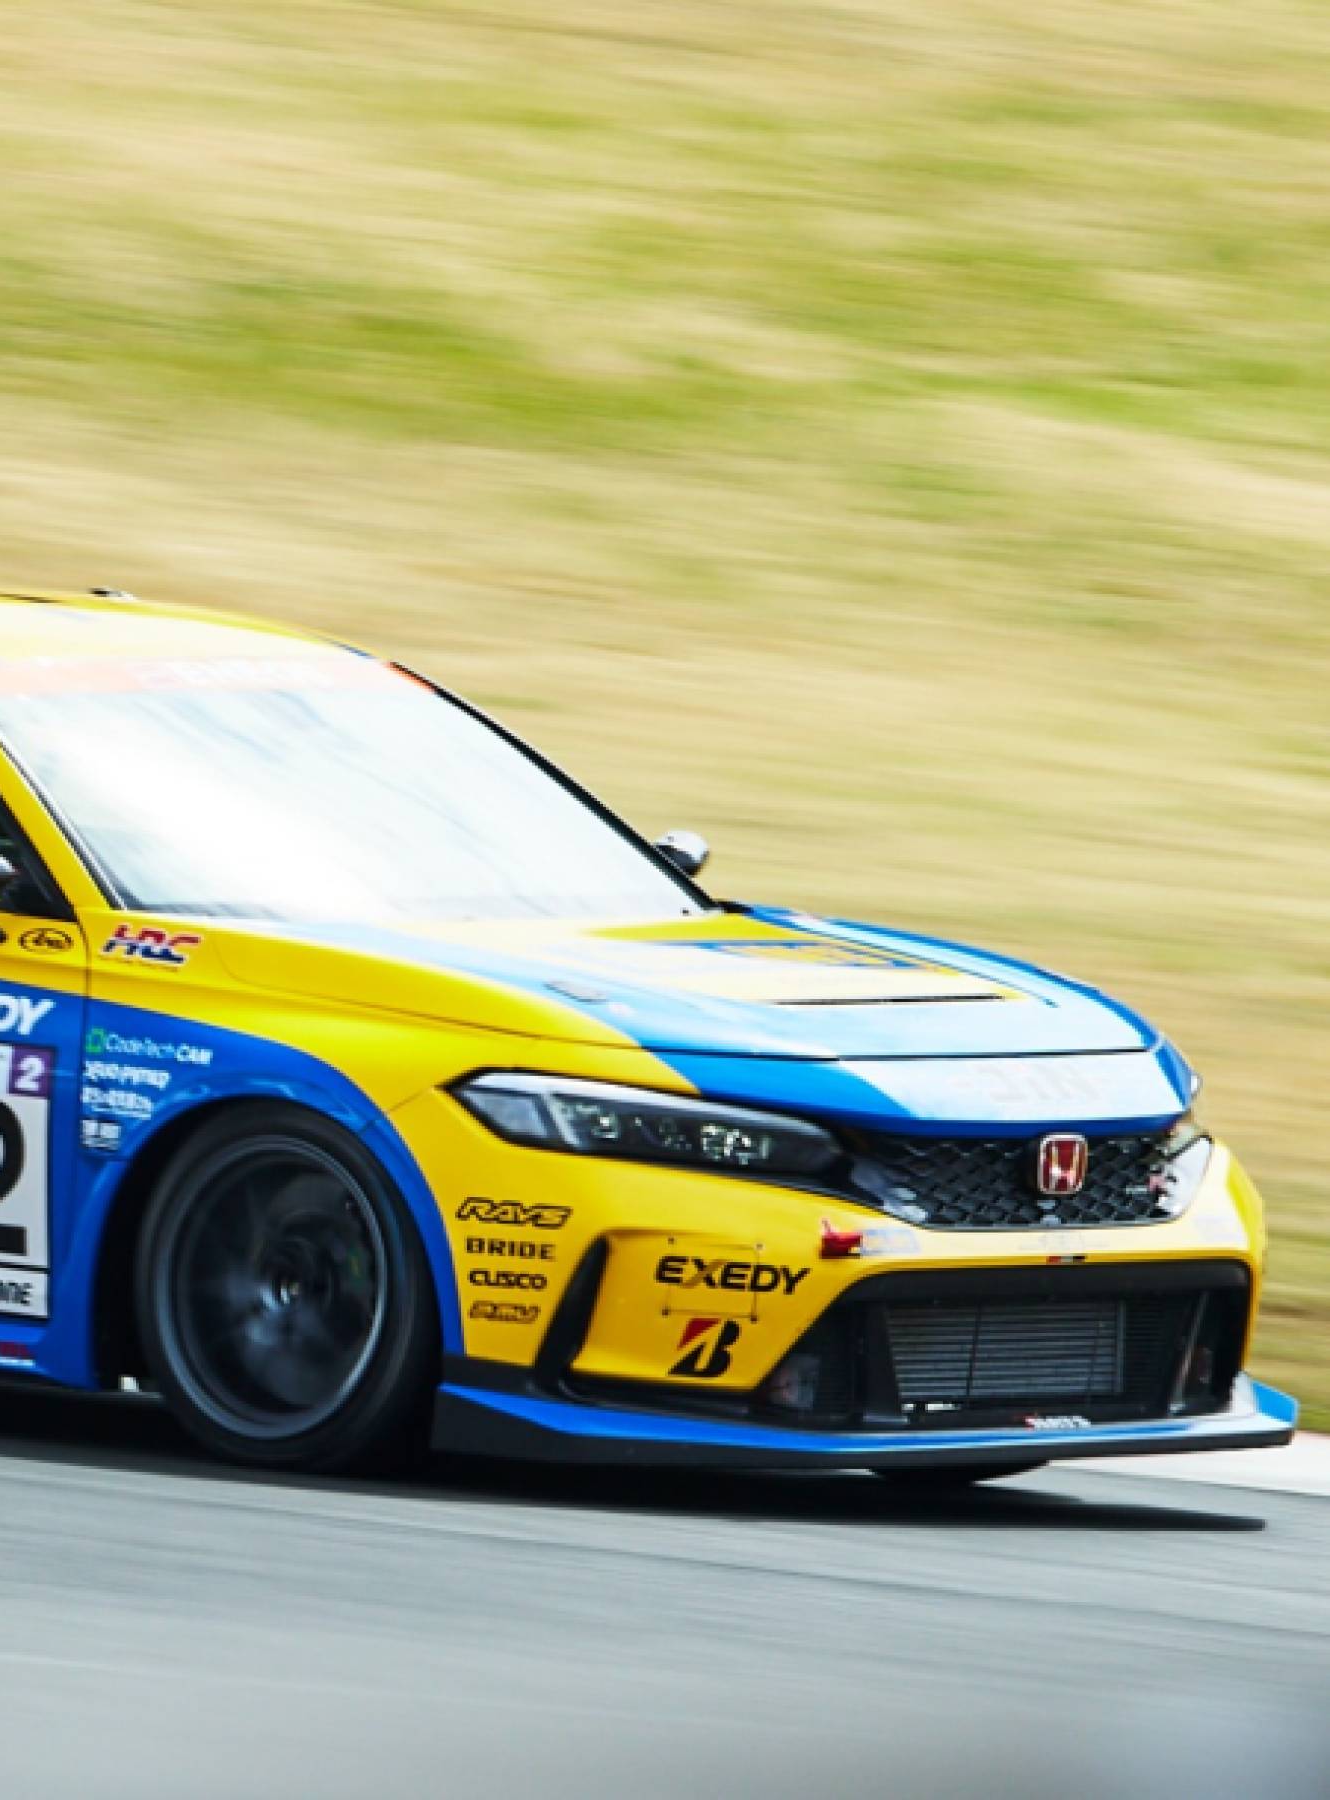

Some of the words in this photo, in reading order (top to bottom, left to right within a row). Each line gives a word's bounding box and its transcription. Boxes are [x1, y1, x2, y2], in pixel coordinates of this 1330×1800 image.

[100, 924, 203, 964] HRC
[13, 1054, 46, 1091] 2
[456, 1196, 572, 1230] RAYS
[466, 1237, 556, 1261] BRIDE
[469, 1269, 547, 1290] CUSCO
[654, 1254, 810, 1295] EXEDY
